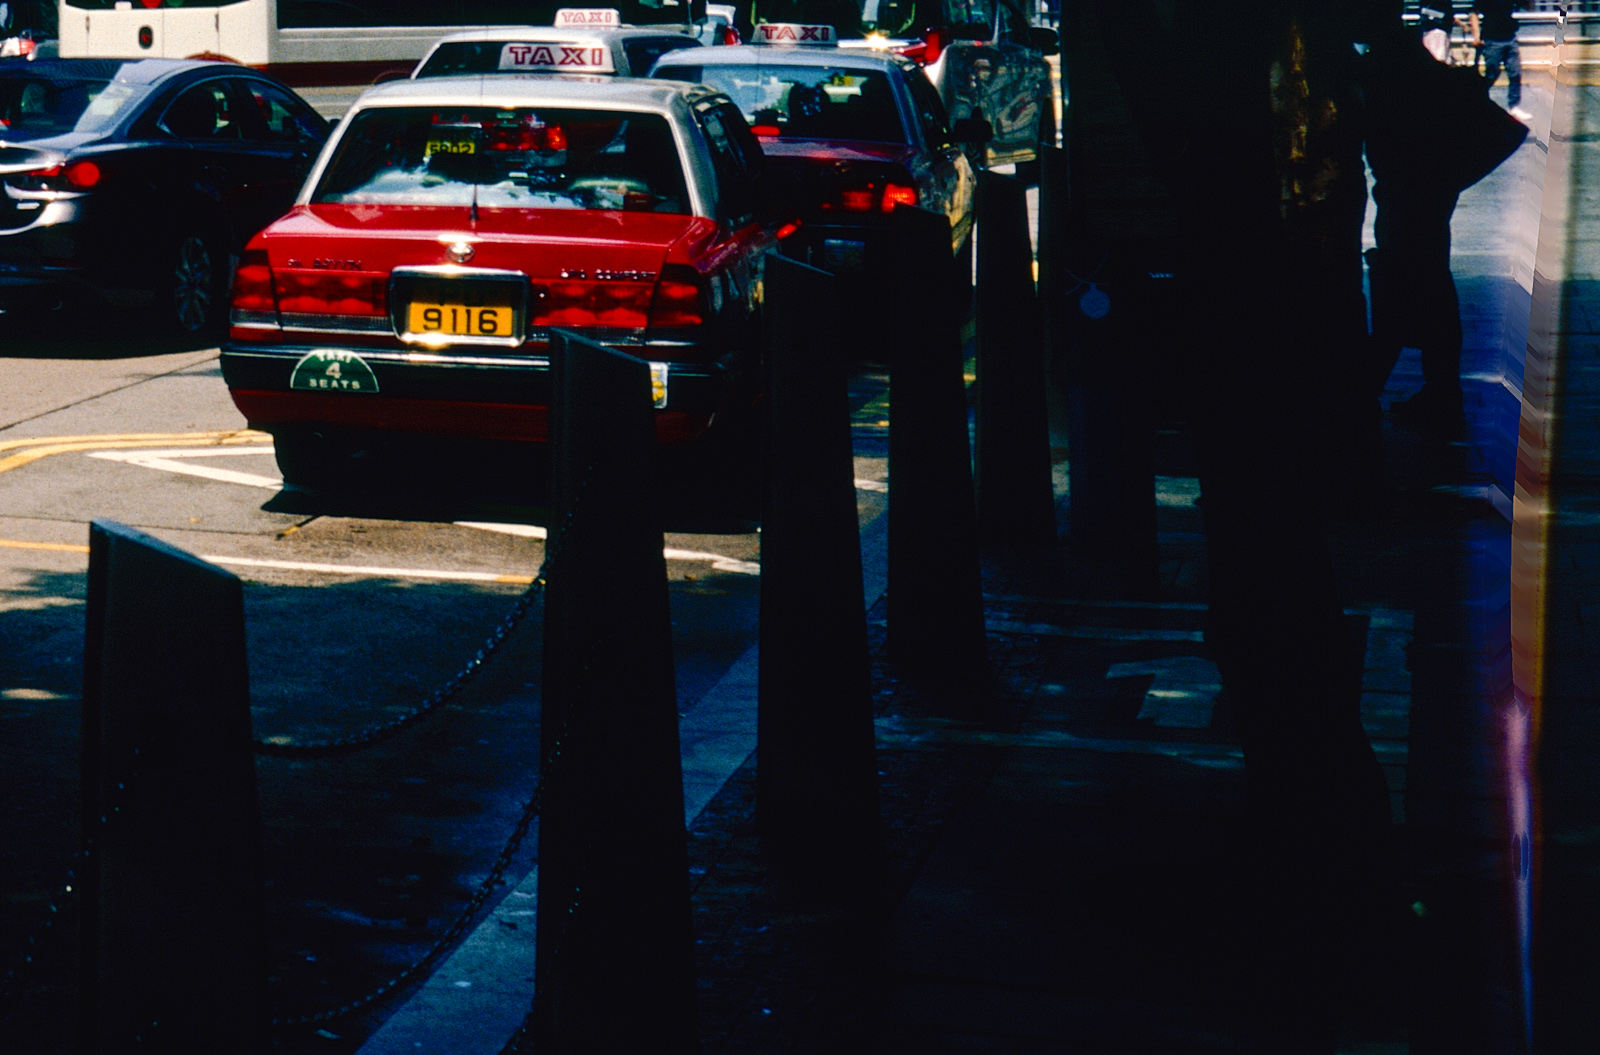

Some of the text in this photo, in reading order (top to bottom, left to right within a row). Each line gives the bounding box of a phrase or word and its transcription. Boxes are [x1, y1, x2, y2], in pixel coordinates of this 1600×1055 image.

[560, 10, 614, 25] TAXI
[760, 26, 830, 41] TAXI
[509, 46, 604, 66] TAXI
[423, 308, 498, 334] 9116
[325, 362, 342, 380] 4
[309, 378, 360, 391] SEATS
